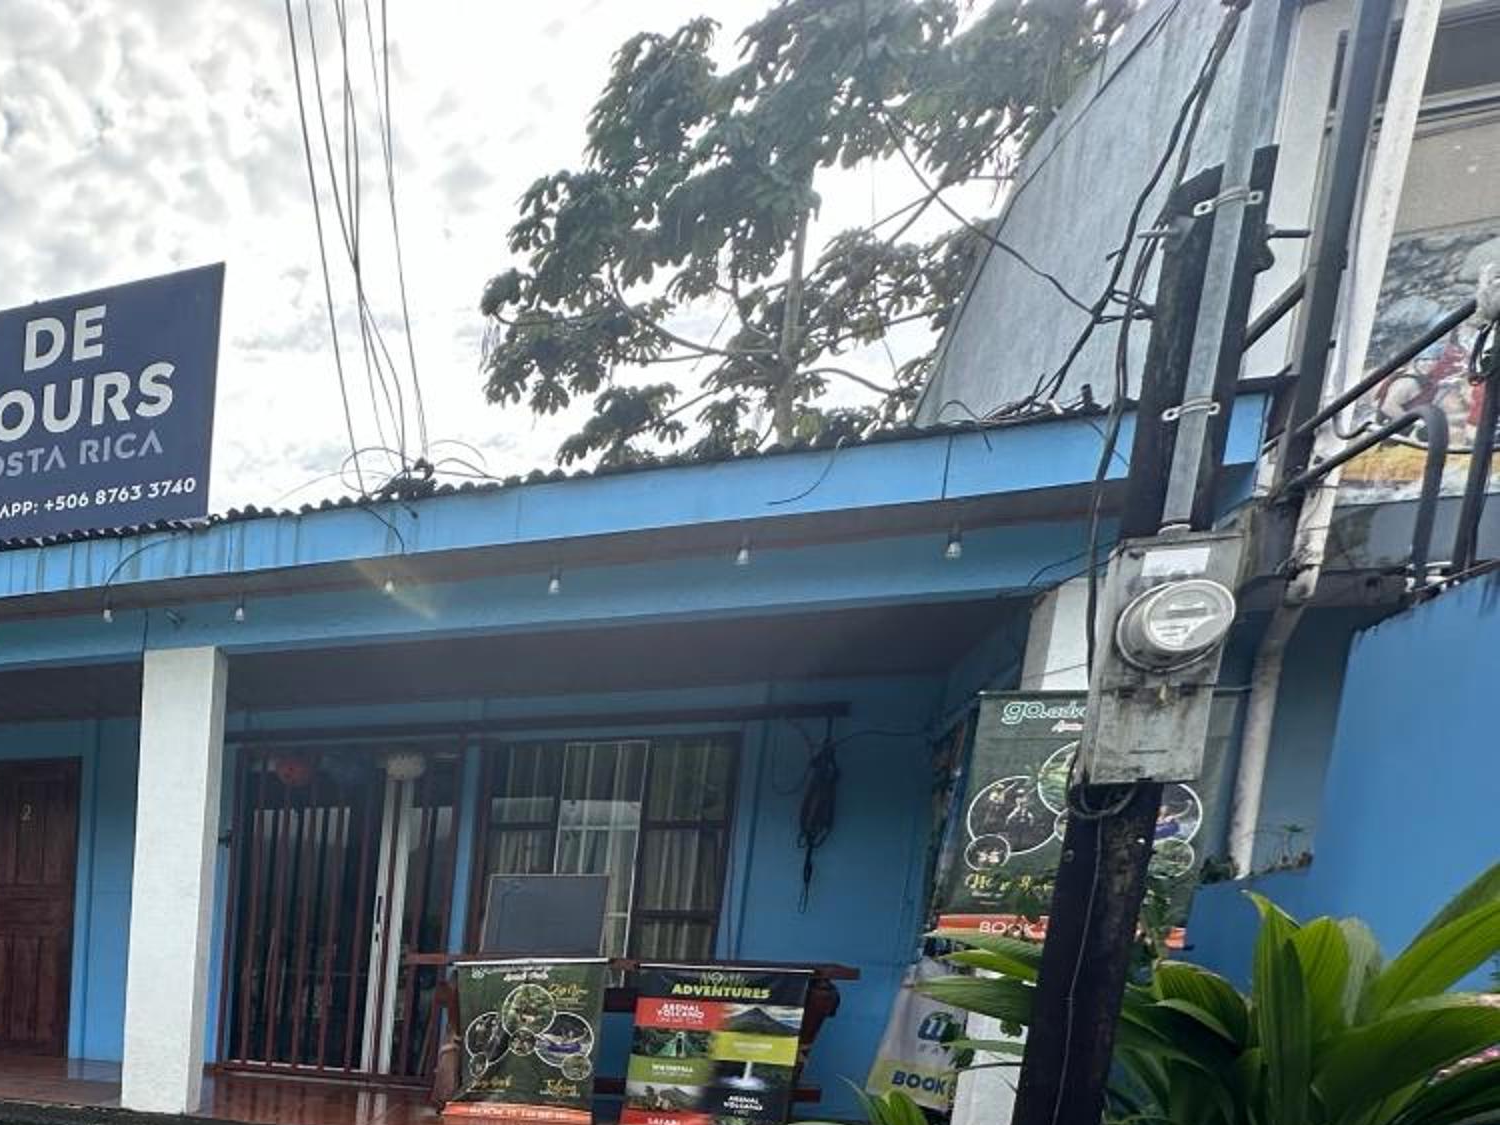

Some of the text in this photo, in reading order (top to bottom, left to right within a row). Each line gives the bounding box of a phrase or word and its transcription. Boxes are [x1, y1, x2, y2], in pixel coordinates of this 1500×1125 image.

[23, 304, 107, 372] DE
[79, 429, 164, 465] RICA
[44, 492, 90, 512] +506
[95, 483, 143, 506] 8763
[147, 477, 198, 498] 3740
[671, 983, 772, 999] ADVENTURES
[891, 1070, 947, 1096] BOOK
